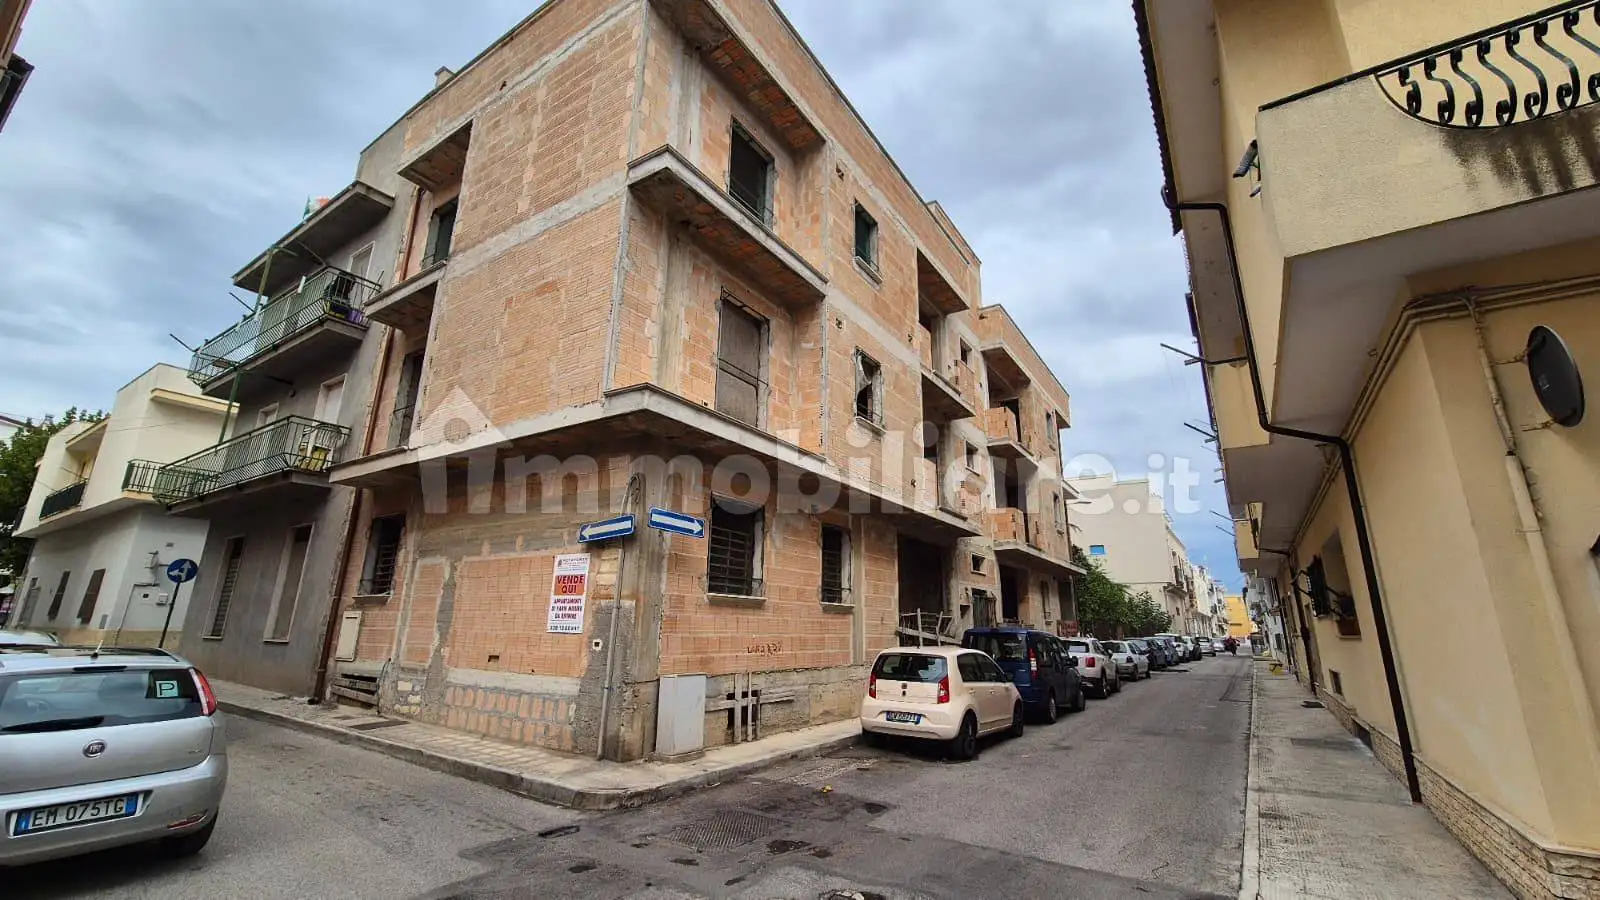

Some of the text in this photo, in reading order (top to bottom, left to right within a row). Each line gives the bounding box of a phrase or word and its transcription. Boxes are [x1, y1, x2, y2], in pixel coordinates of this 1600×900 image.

[556, 575, 584, 584] VENDE
[561, 585, 577, 593] QUI
[159, 682, 175, 696] P
[32, 798, 125, 827] EM 075TG
